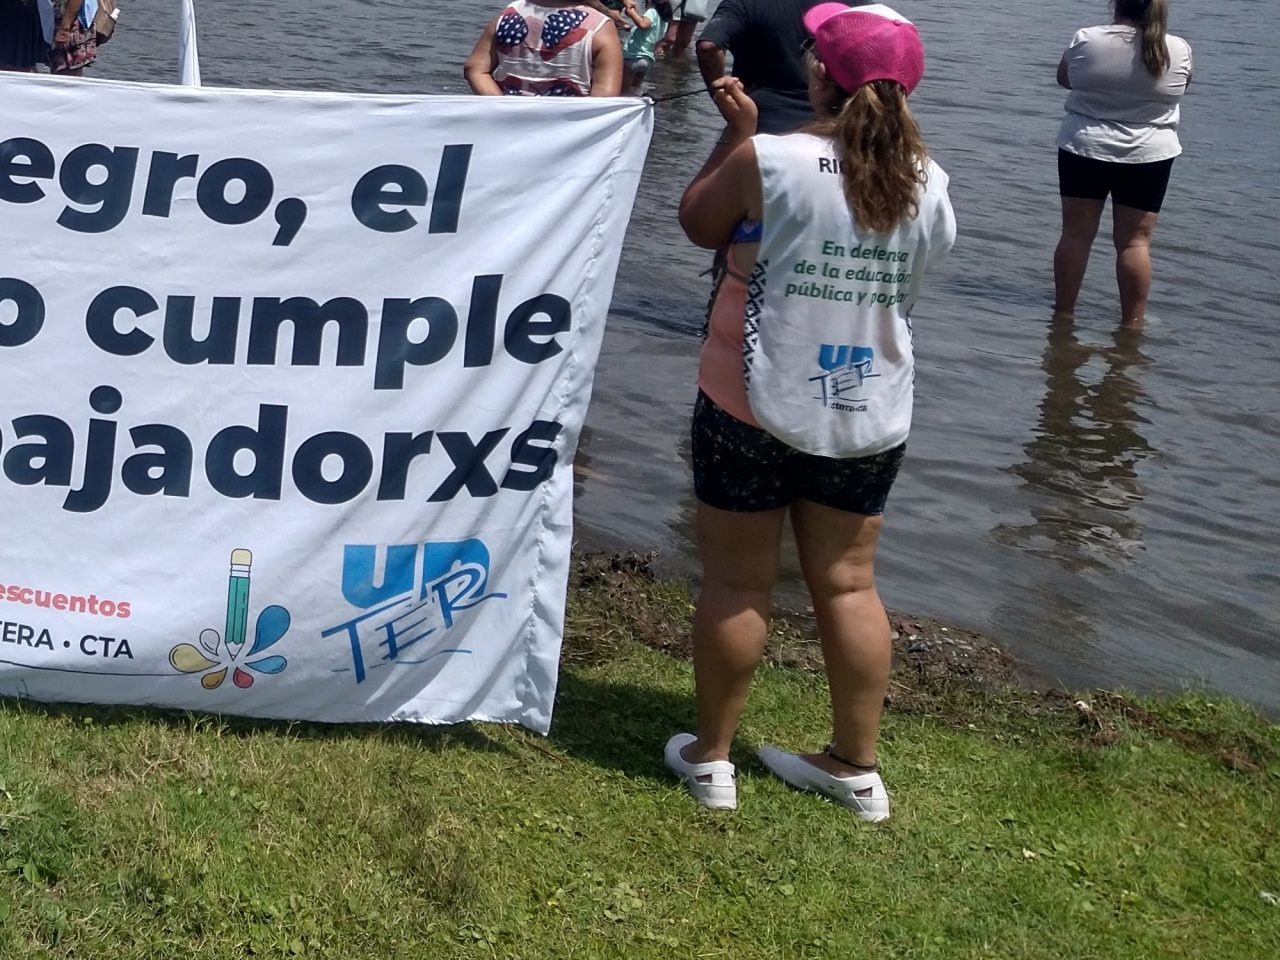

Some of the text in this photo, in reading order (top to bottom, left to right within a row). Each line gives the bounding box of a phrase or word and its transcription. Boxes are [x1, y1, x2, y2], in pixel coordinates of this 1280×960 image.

[352, 143, 473, 234] el
[822, 240, 846, 257] En
[794, 259, 817, 275] de
[822, 262, 841, 279] la
[784, 281, 854, 302] pública
[856, 291, 868, 306] y
[86, 274, 572, 390] cumple
[80, 634, 134, 660] CTA
